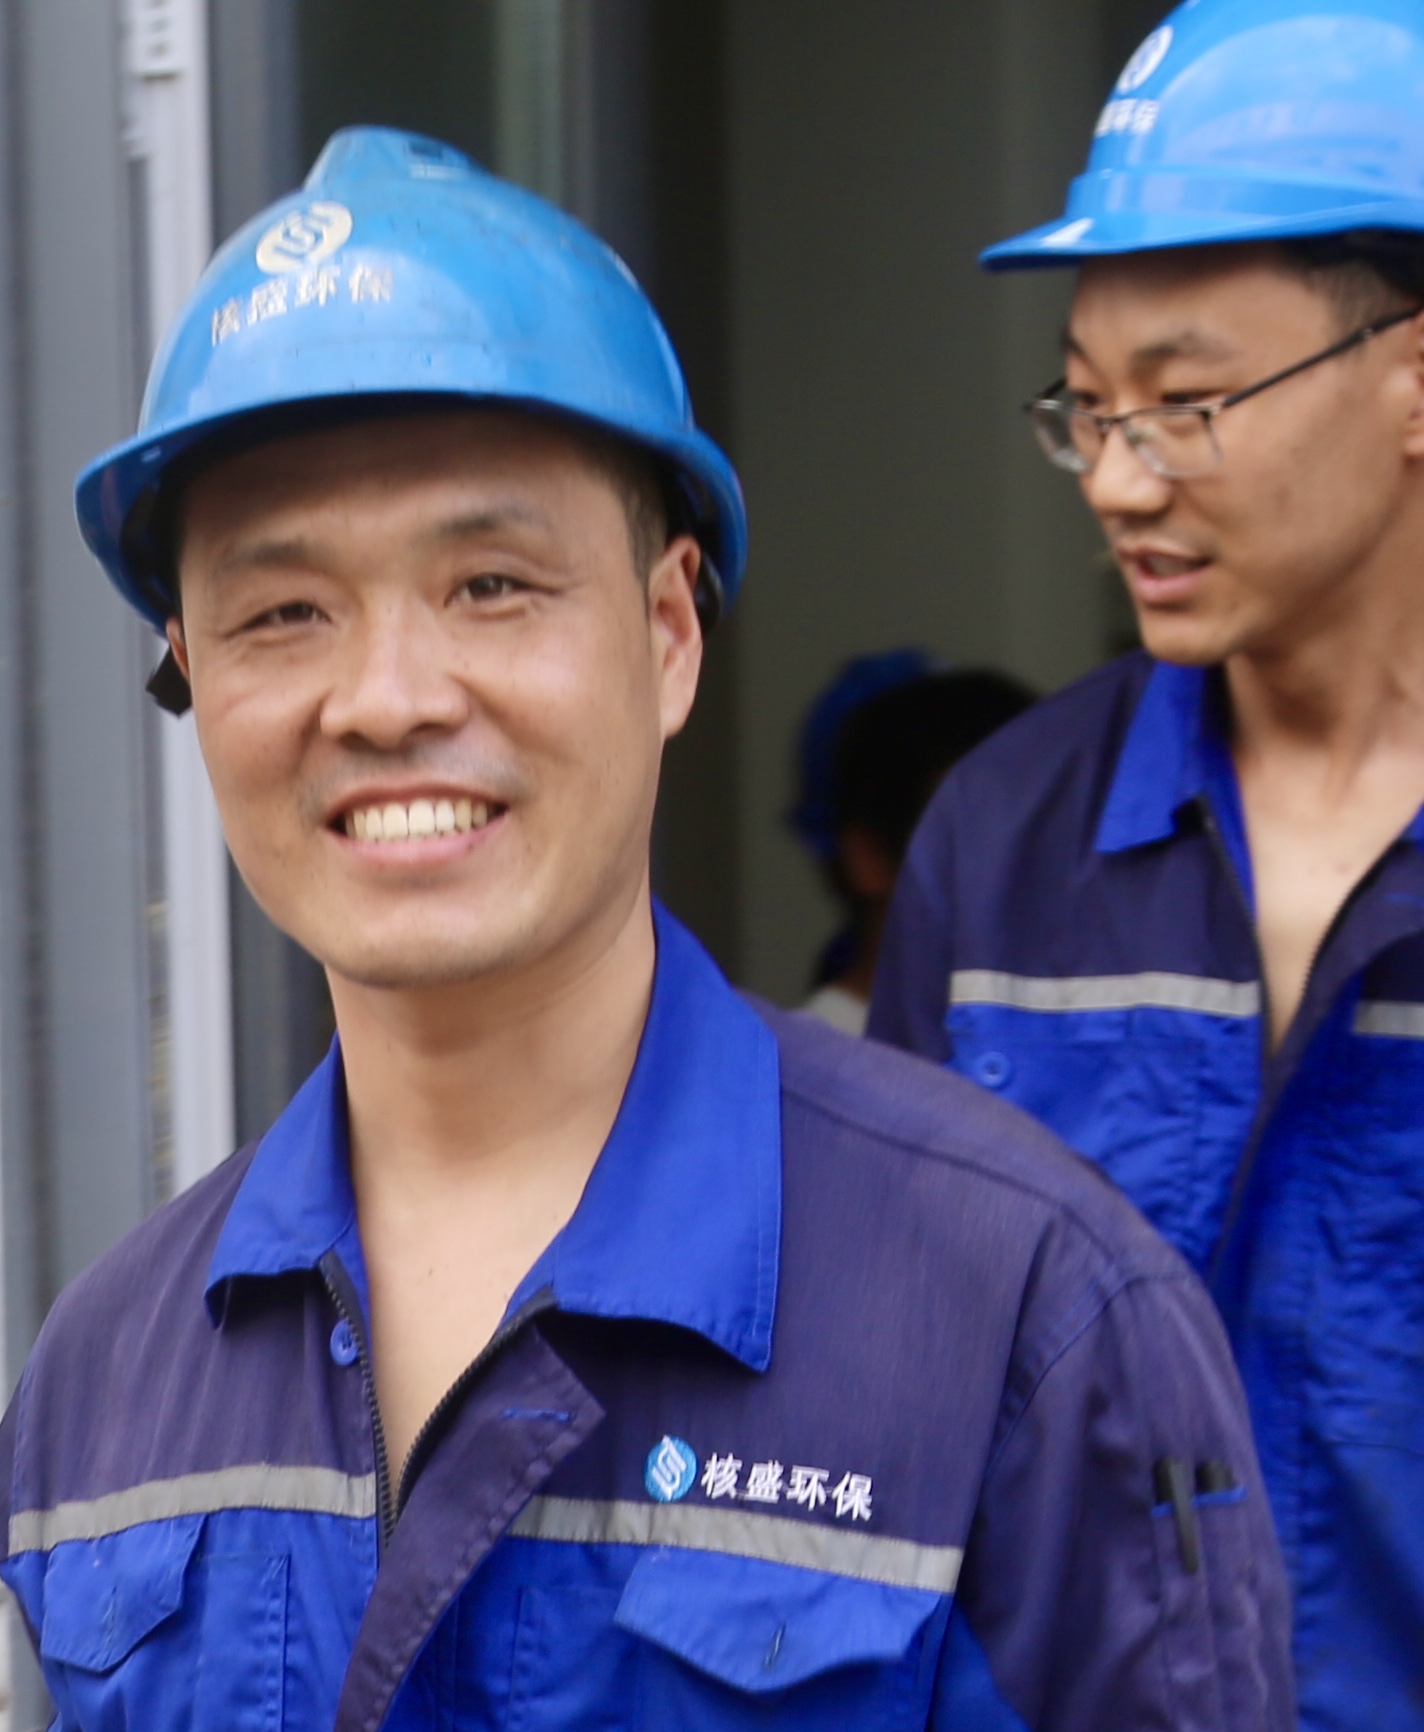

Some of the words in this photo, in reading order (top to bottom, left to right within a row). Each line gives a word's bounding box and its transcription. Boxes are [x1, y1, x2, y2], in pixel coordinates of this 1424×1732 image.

[211, 263, 393, 347] 核盛环保
[701, 1453, 873, 1521] 核盛环保
